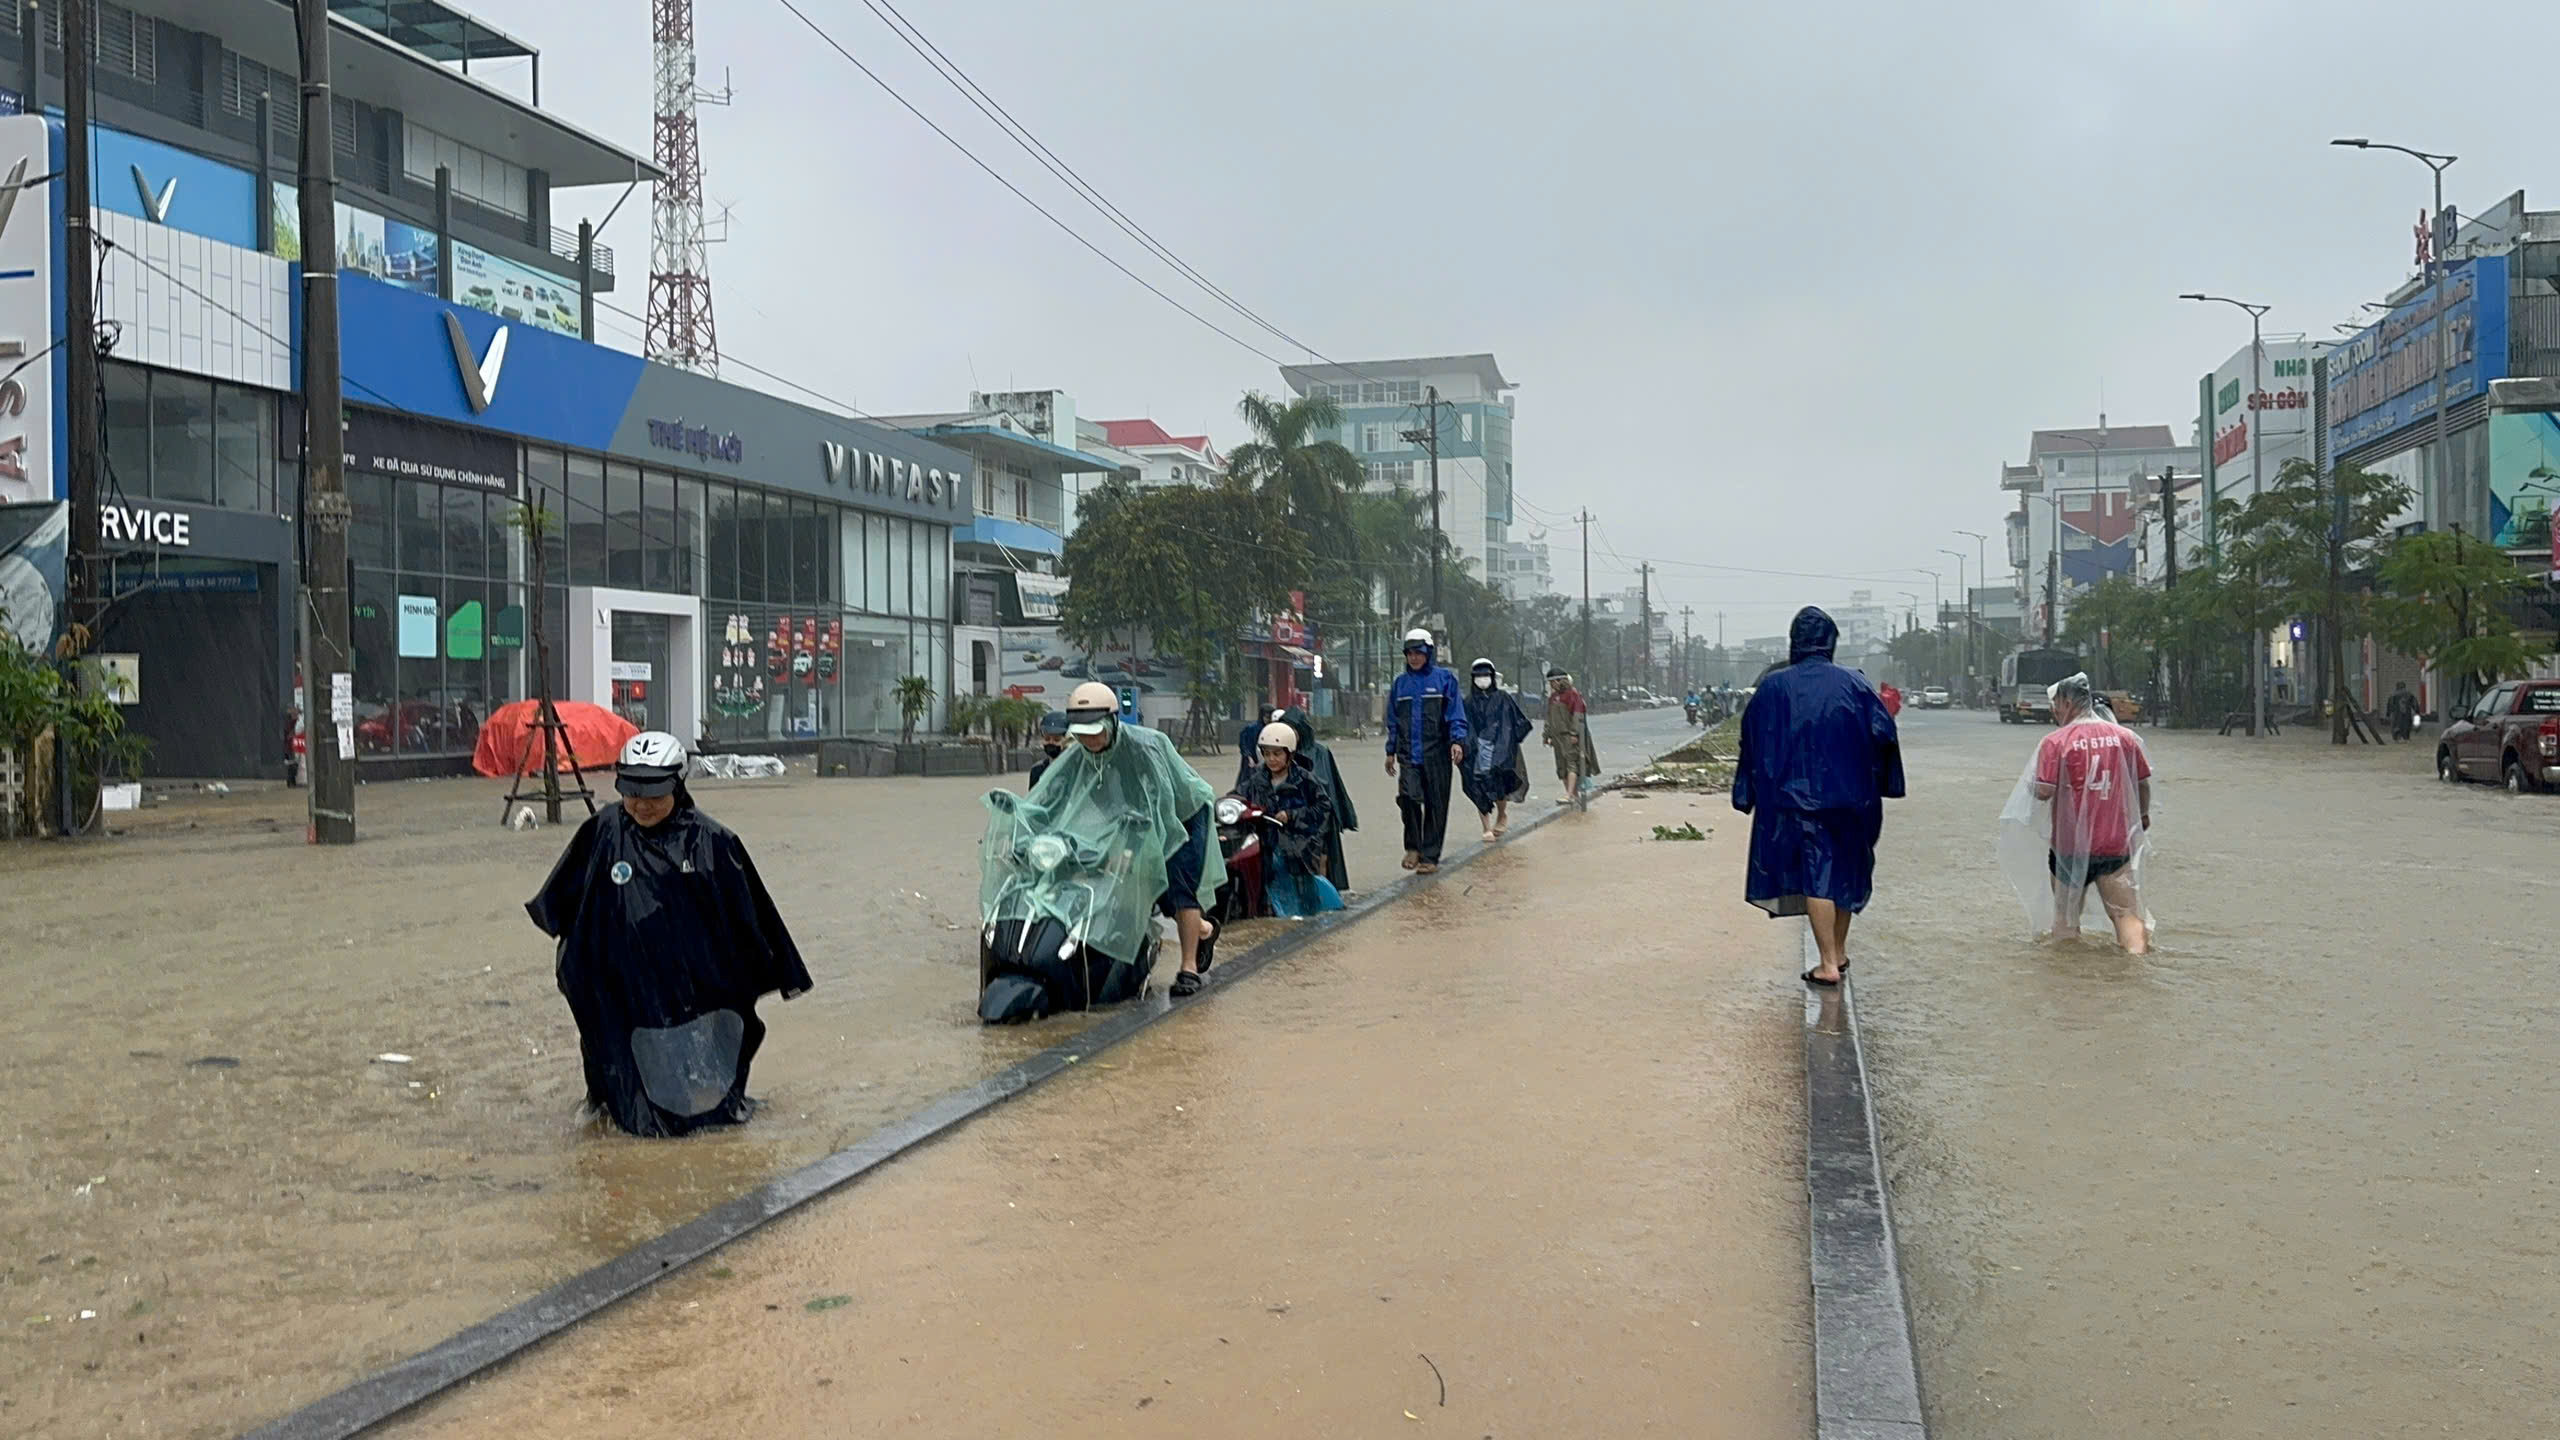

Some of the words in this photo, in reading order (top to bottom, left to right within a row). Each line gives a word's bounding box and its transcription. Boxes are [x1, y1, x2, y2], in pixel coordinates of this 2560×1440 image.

[2248, 387, 2273, 411] SÀI
[2276, 385, 2308, 410] GÒN
[372, 456, 385, 469] XE
[400, 461, 419, 475] QUA
[823, 439, 961, 511] VINFAST
[101, 504, 190, 546] RVICE
[403, 603, 422, 615] MINH
[2072, 739, 2088, 751] FC
[2090, 735, 2120, 750] 6789
[2088, 754, 2111, 800] 4
